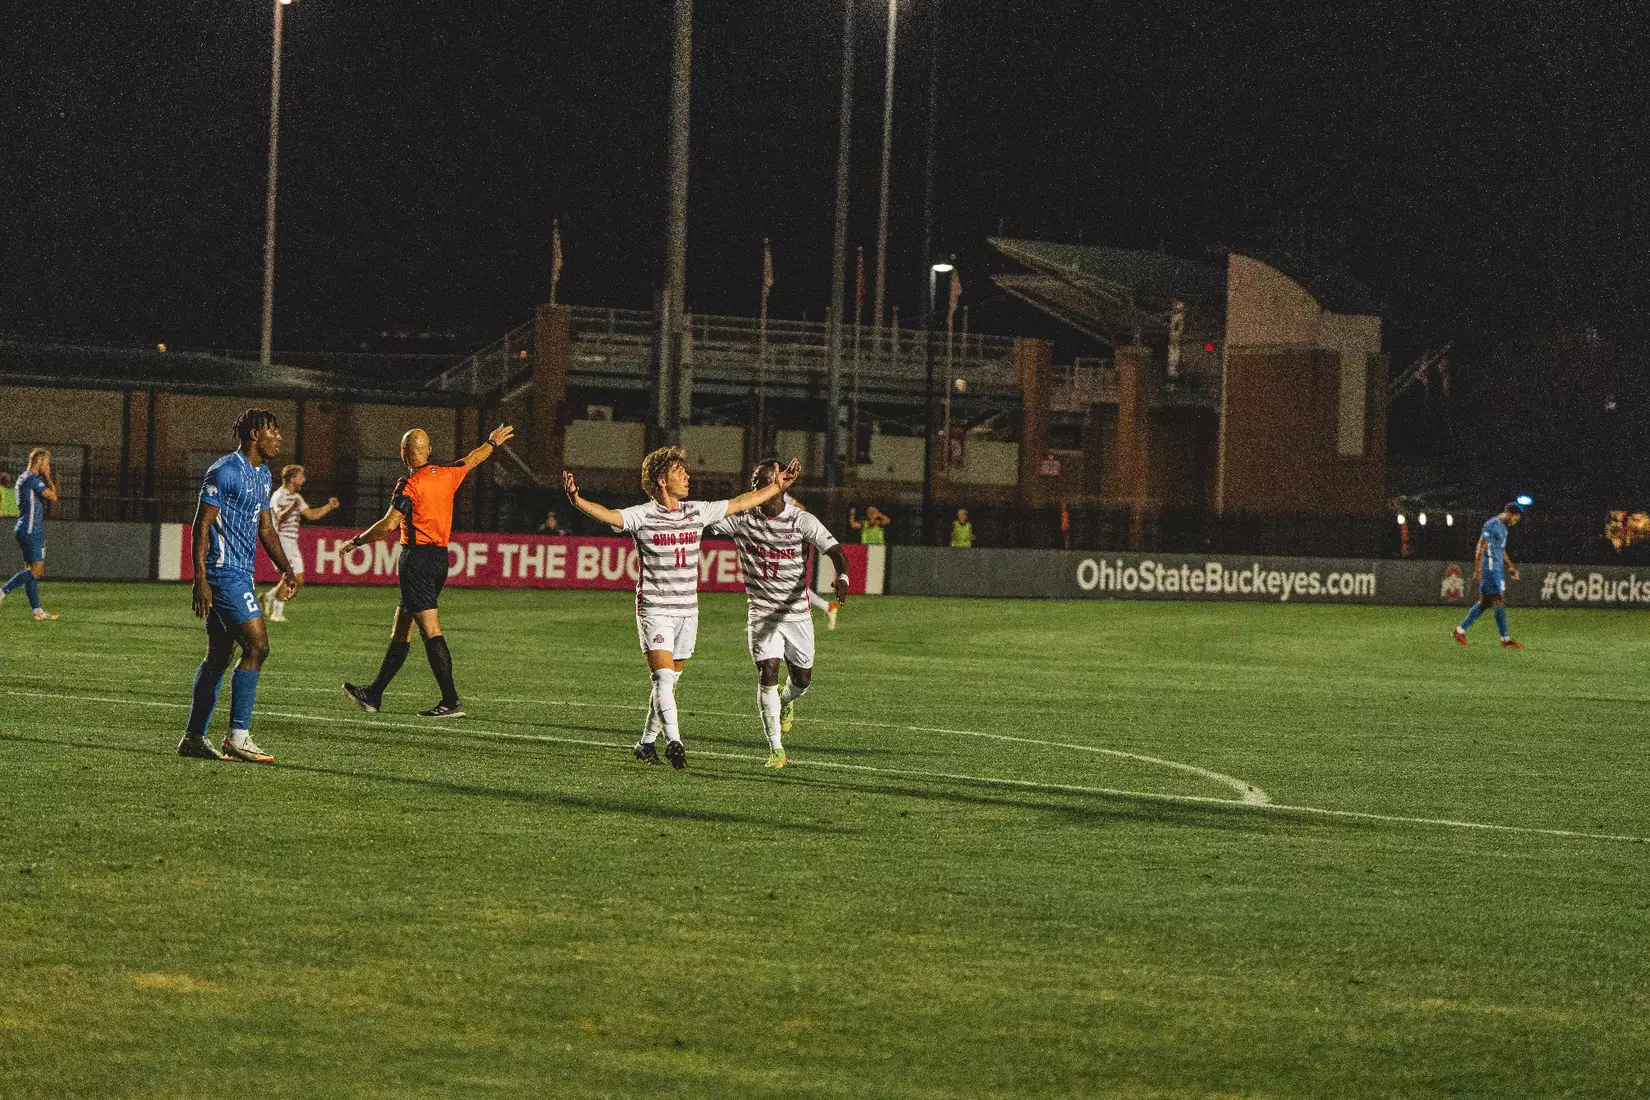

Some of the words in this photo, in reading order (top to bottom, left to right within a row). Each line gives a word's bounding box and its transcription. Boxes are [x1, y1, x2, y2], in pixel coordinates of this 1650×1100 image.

[653, 533, 677, 546] OHIO
[679, 531, 698, 545] STAT
[315, 538, 400, 576] HOM
[447, 541, 488, 578] OF
[497, 543, 568, 579] THE
[575, 545, 745, 584] BUCYE
[675, 547, 687, 568] 11
[762, 561, 780, 581] 17
[1077, 558, 1376, 601] OhioStateBuckeyes.com
[1541, 571, 1650, 602] #GoBucks
[243, 591, 259, 613] 2
